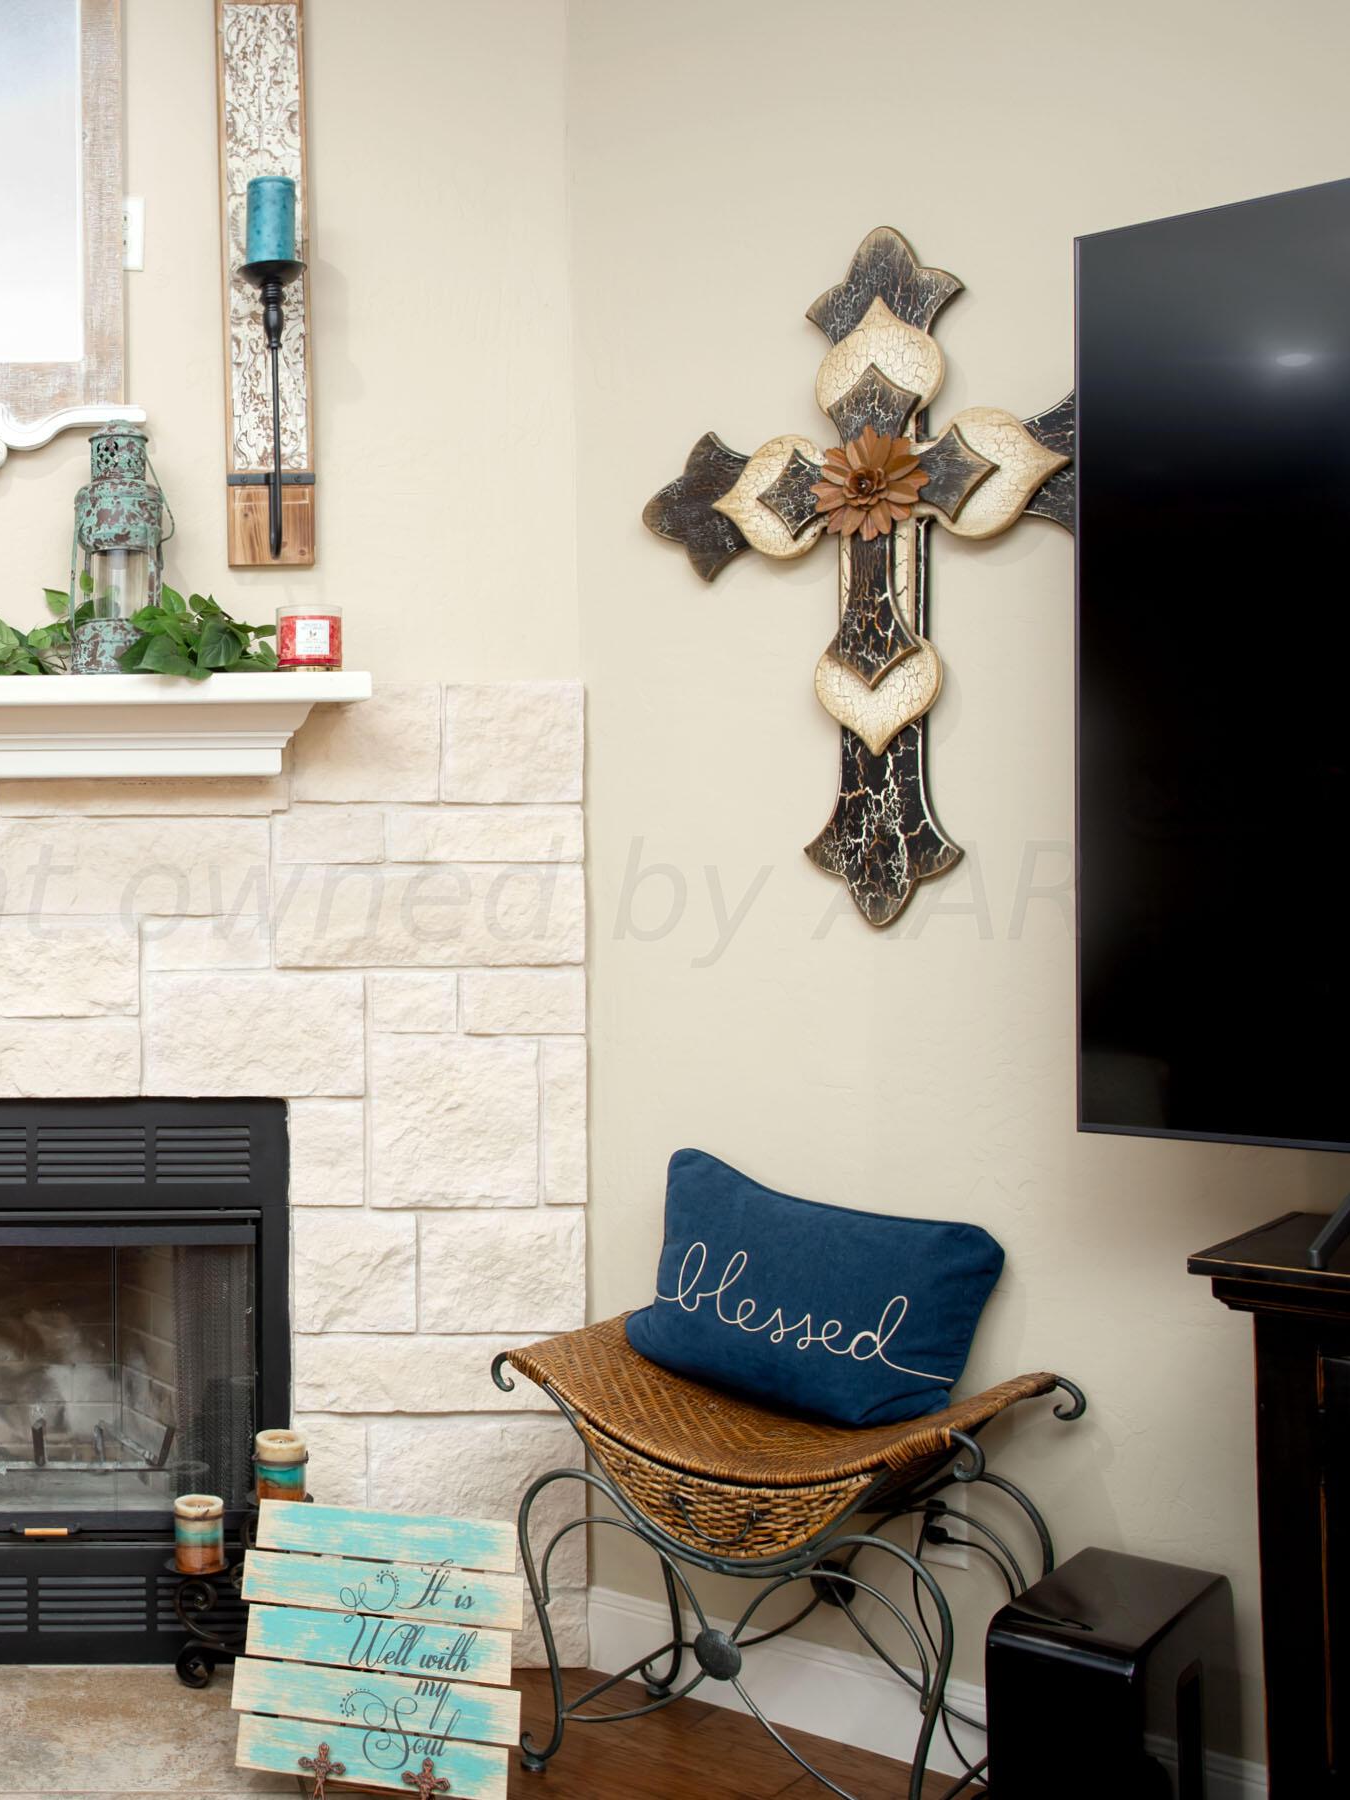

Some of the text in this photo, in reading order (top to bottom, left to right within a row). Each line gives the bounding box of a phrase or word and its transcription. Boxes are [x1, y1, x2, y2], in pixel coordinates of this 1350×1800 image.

[657, 1242, 954, 1382] blessed
[396, 1558, 476, 1610] It is
[343, 1613, 478, 1672] Well with
[362, 1696, 462, 1771] Soul
[414, 1679, 452, 1730] my
